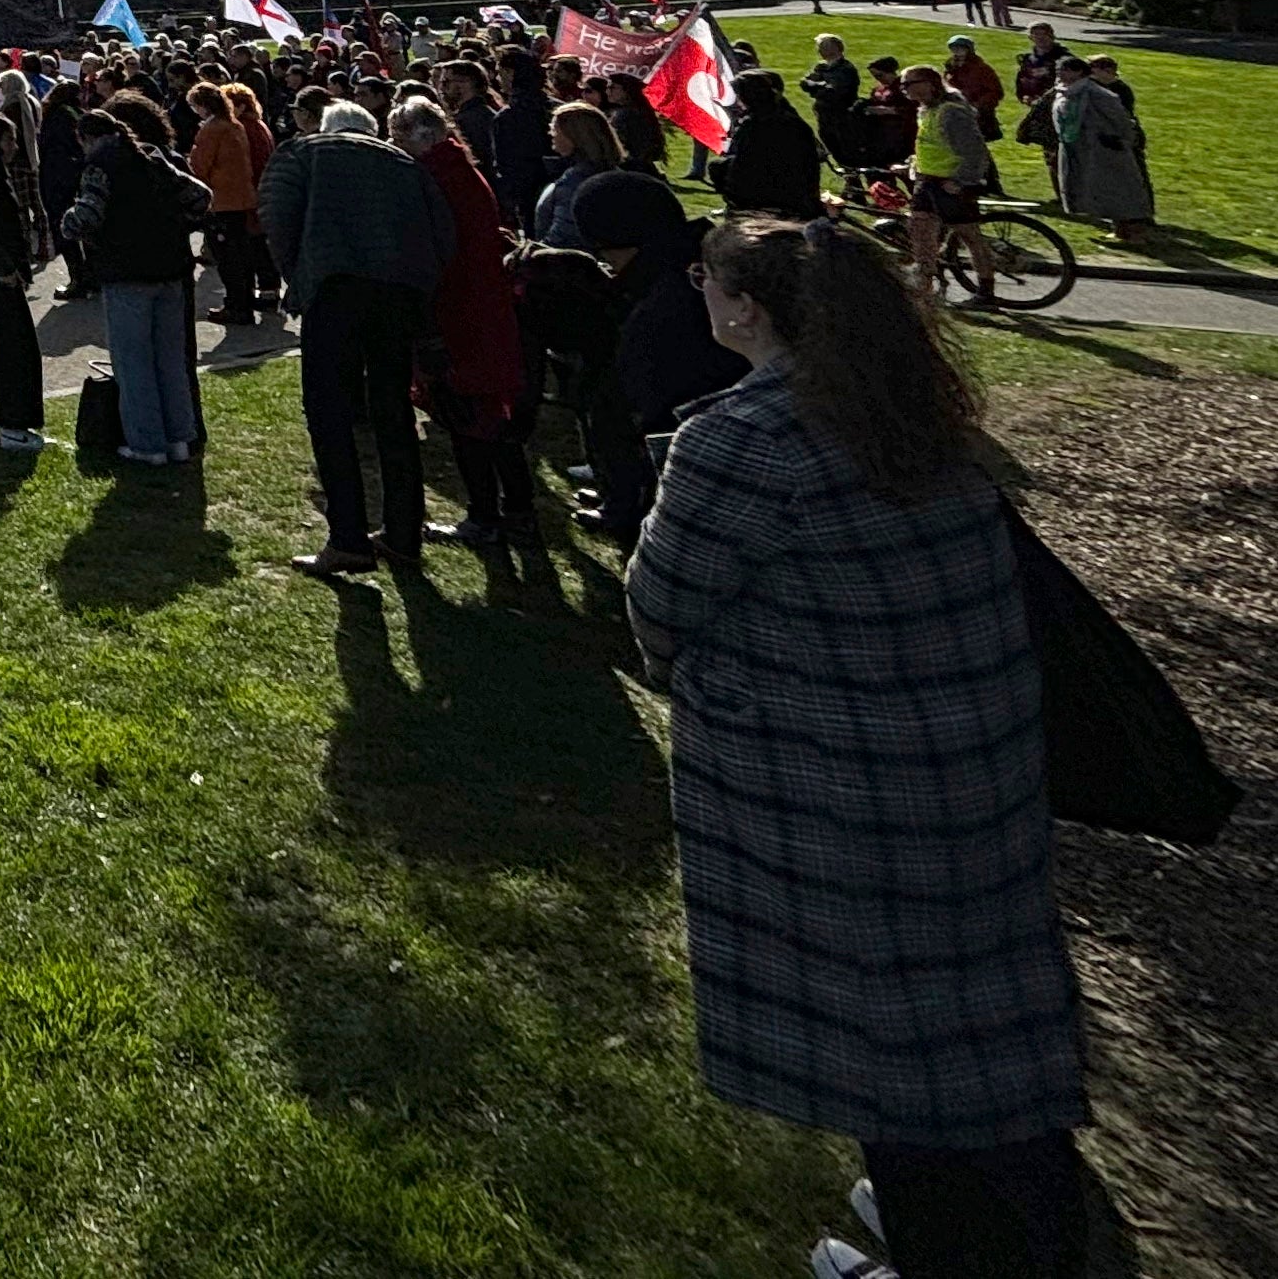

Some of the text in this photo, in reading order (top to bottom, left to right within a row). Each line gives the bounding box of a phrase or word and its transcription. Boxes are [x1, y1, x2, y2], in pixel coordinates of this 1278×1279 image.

[578, 24, 672, 56] He wak
[579, 52, 651, 79] eke no
